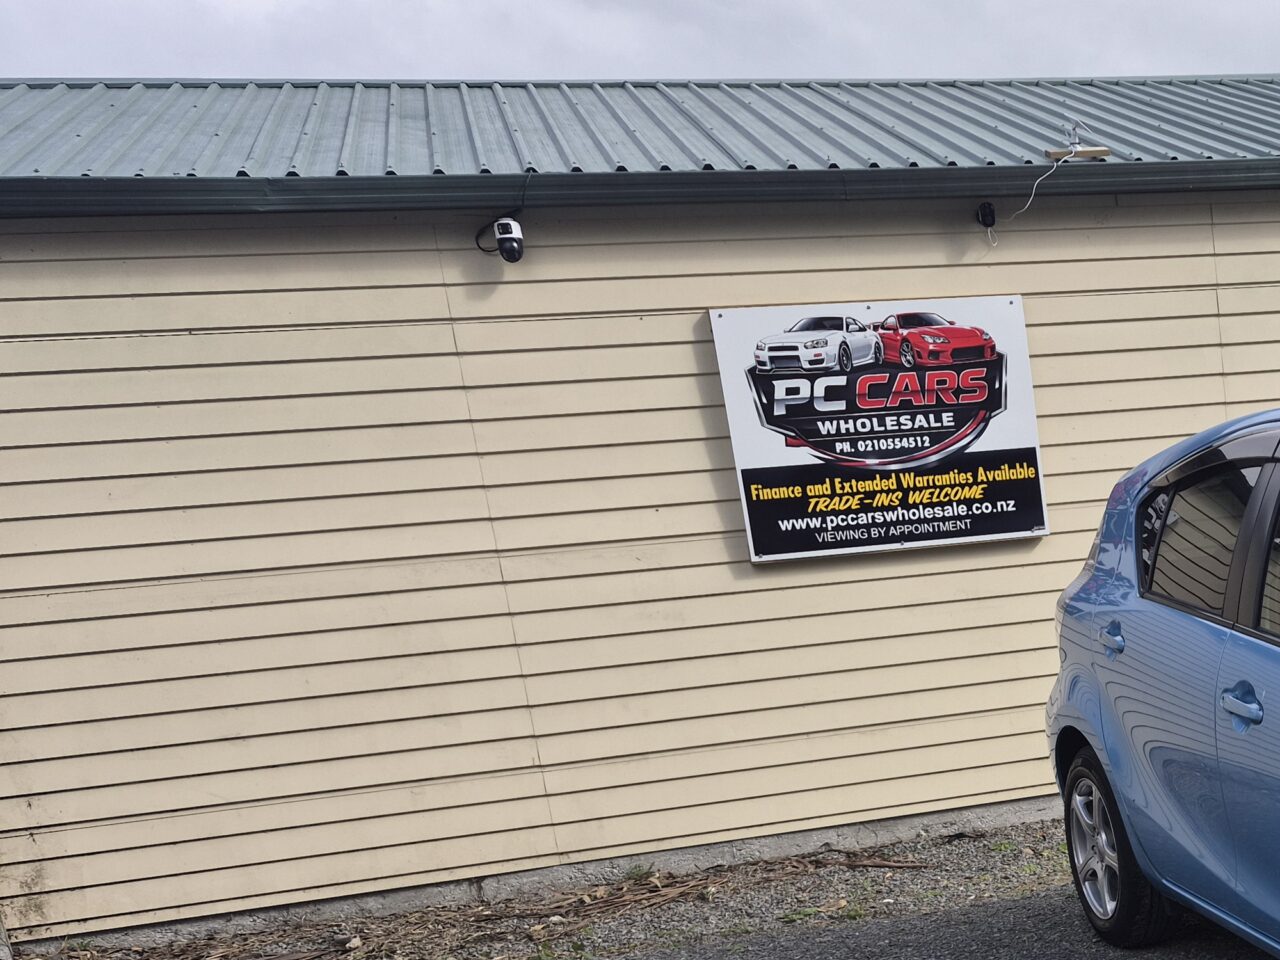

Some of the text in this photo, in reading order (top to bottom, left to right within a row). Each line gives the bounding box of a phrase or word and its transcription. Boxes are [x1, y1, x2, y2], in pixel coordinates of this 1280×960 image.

[773, 368, 989, 416] PC CARS
[816, 412, 956, 435] WHOLESALE
[835, 436, 931, 454] PH. 0210554512
[750, 462, 1036, 501] Finance and Extended Warranties Available
[807, 484, 988, 513] TRADE-INS WELCOME
[778, 500, 1017, 532] www.pccarswholesale.co.nz
[815, 519, 972, 543] VIEWING BY APPOINTMENT
